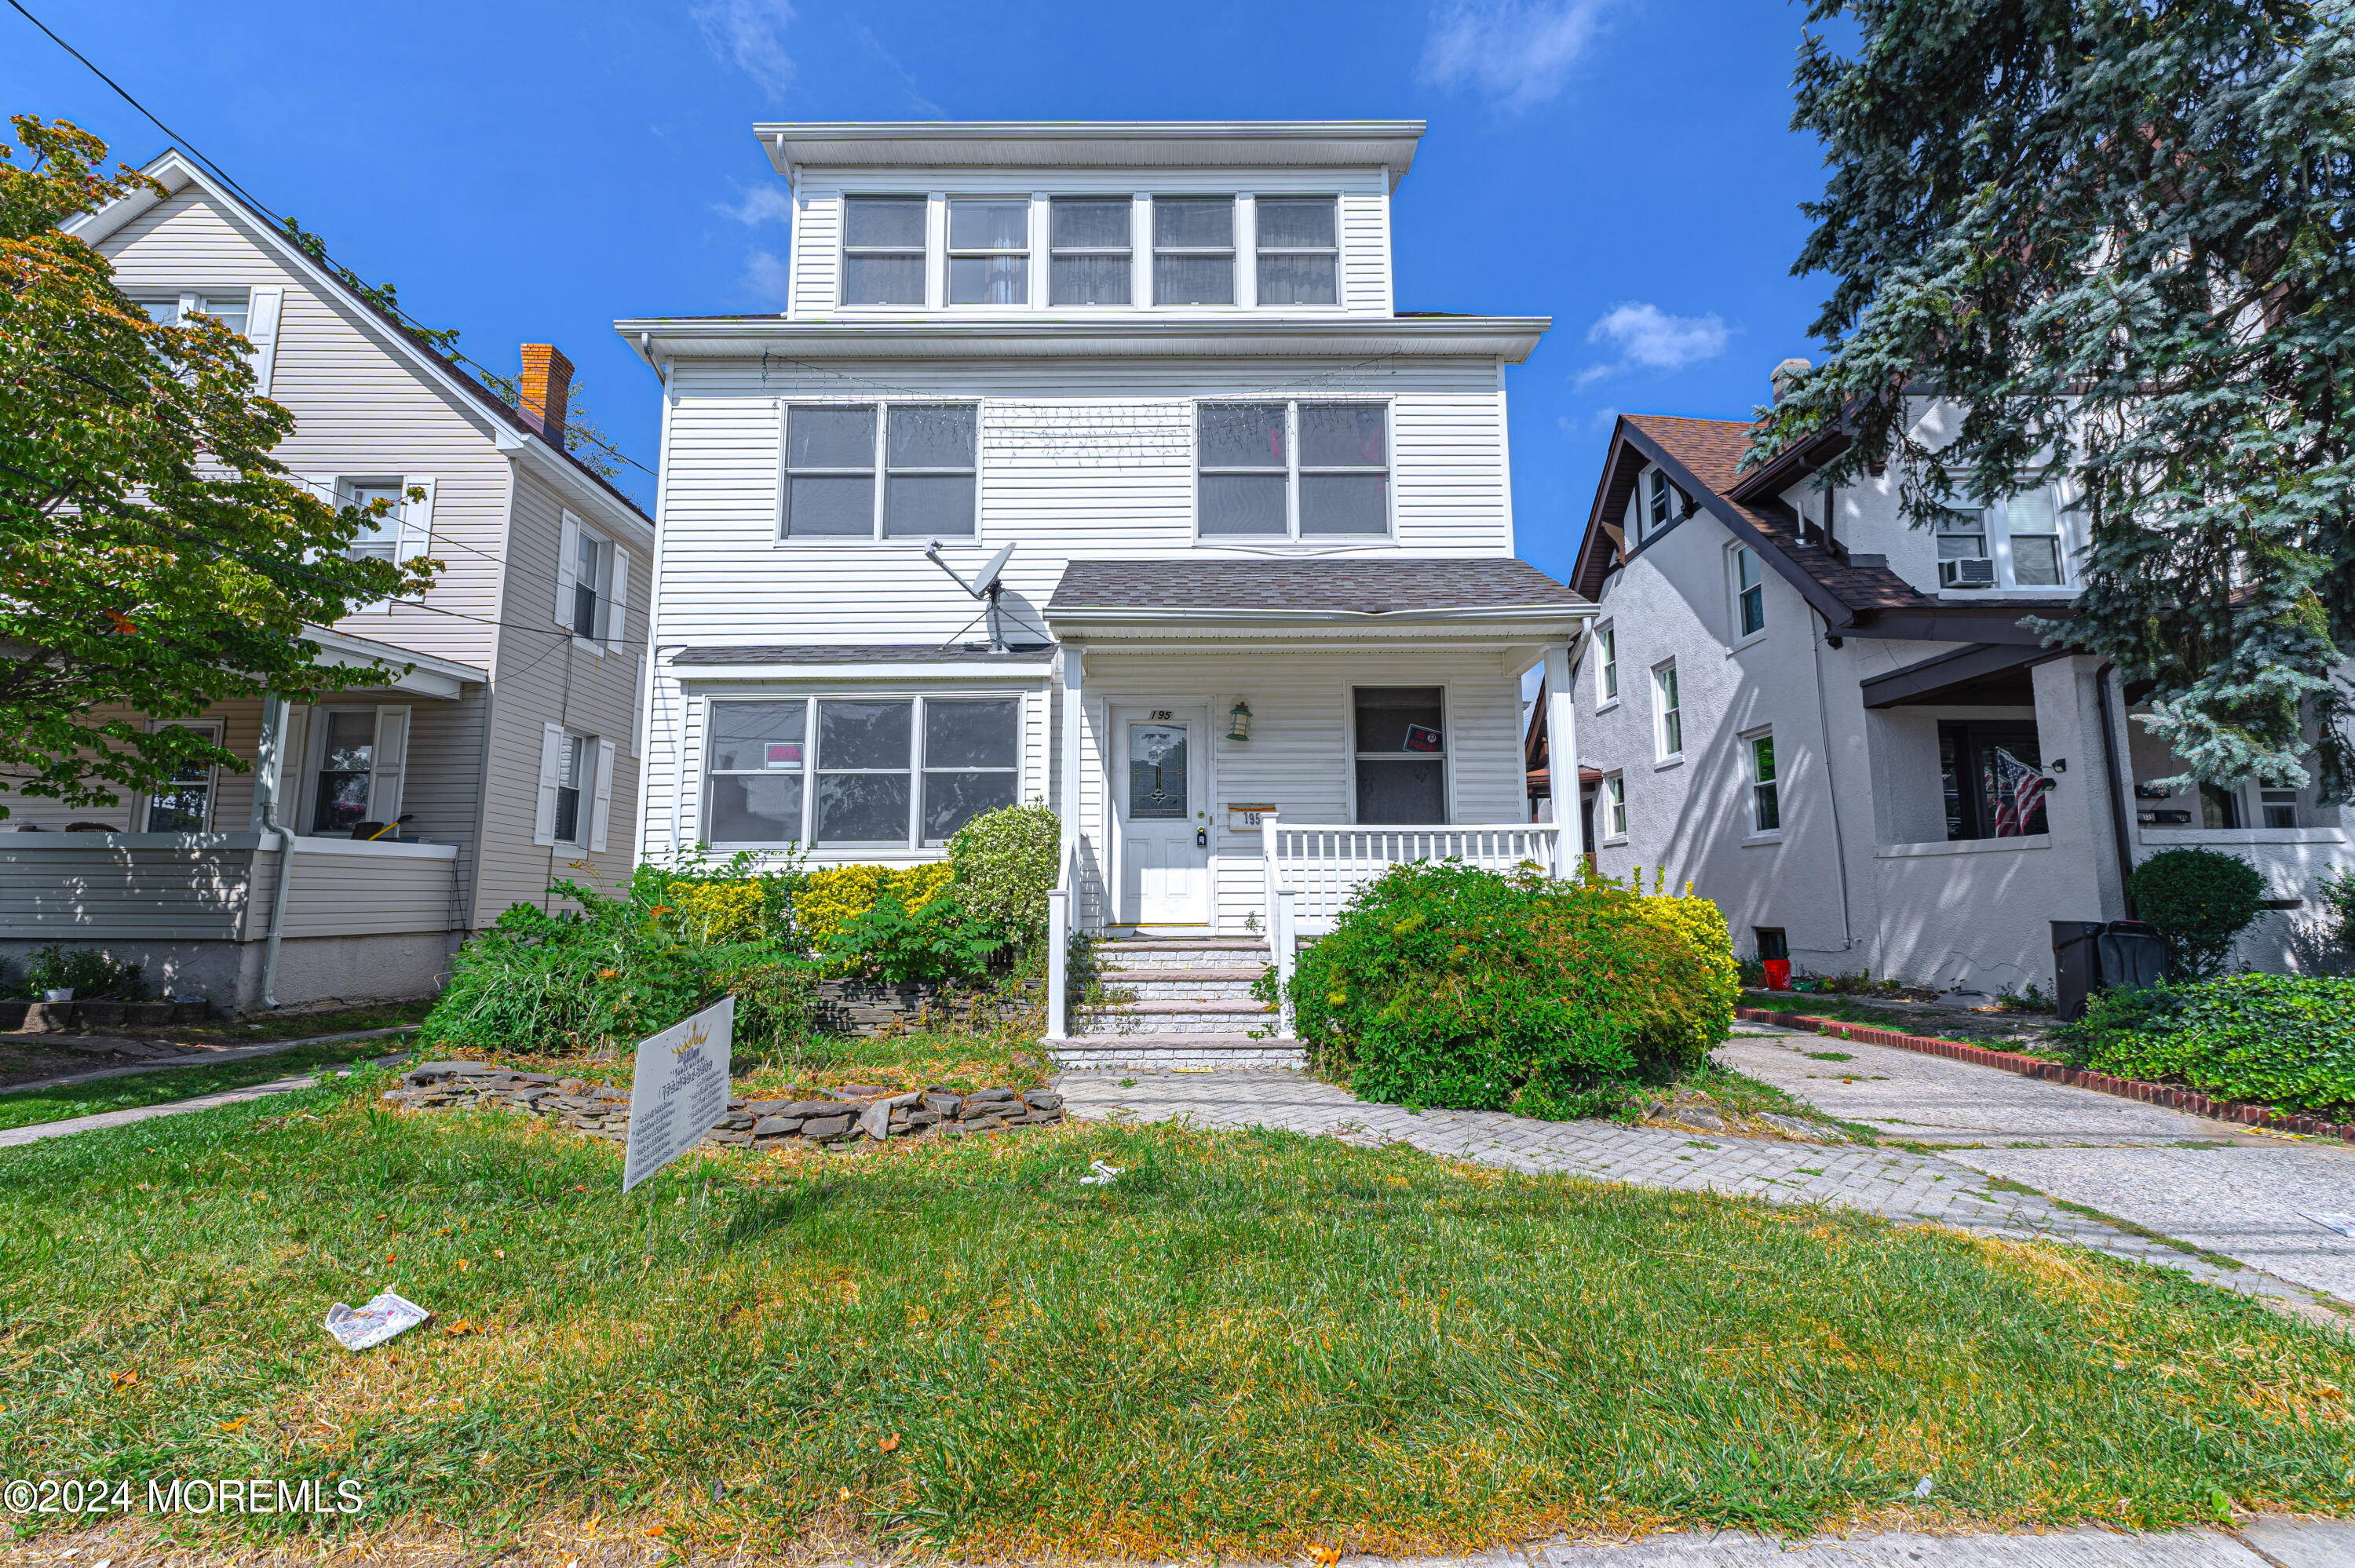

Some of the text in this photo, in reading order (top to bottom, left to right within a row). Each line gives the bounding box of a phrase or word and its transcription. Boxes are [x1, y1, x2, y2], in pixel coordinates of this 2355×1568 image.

[1151, 710, 1172, 720] 195
[1415, 730, 1426, 740] NO
[1244, 811, 1261, 825] 195
